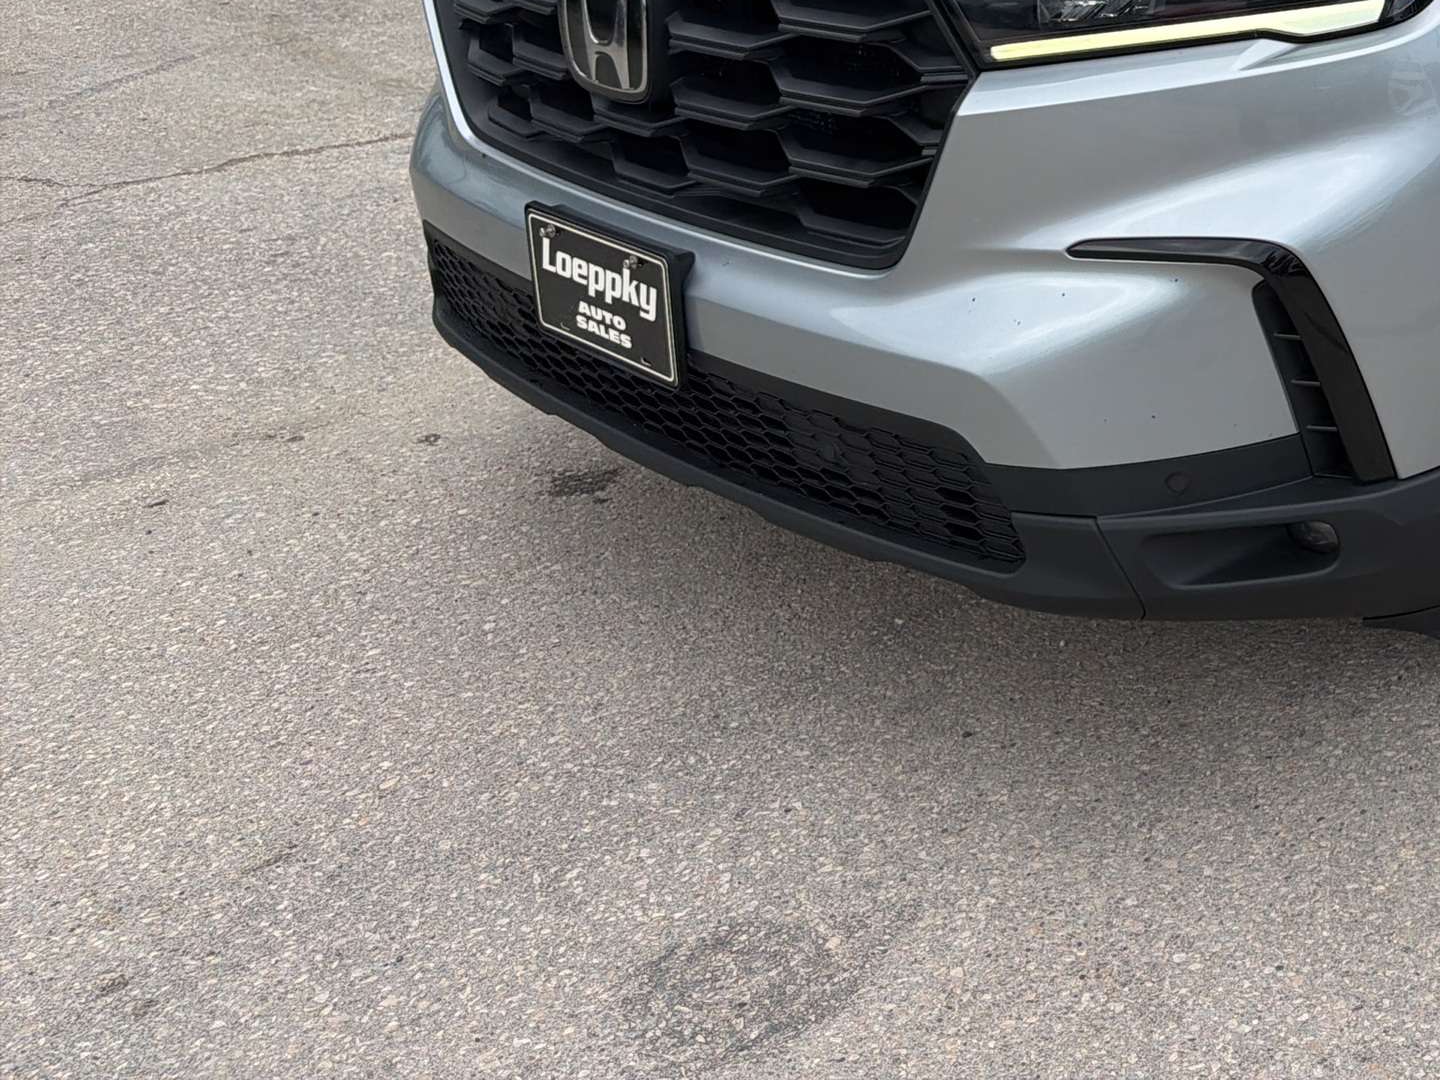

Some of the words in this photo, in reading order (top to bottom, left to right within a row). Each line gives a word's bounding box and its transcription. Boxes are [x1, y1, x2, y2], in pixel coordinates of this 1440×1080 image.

[541, 237, 658, 322] Loeppky
[576, 315, 632, 349] SALES
[578, 301, 627, 331] AUTO
